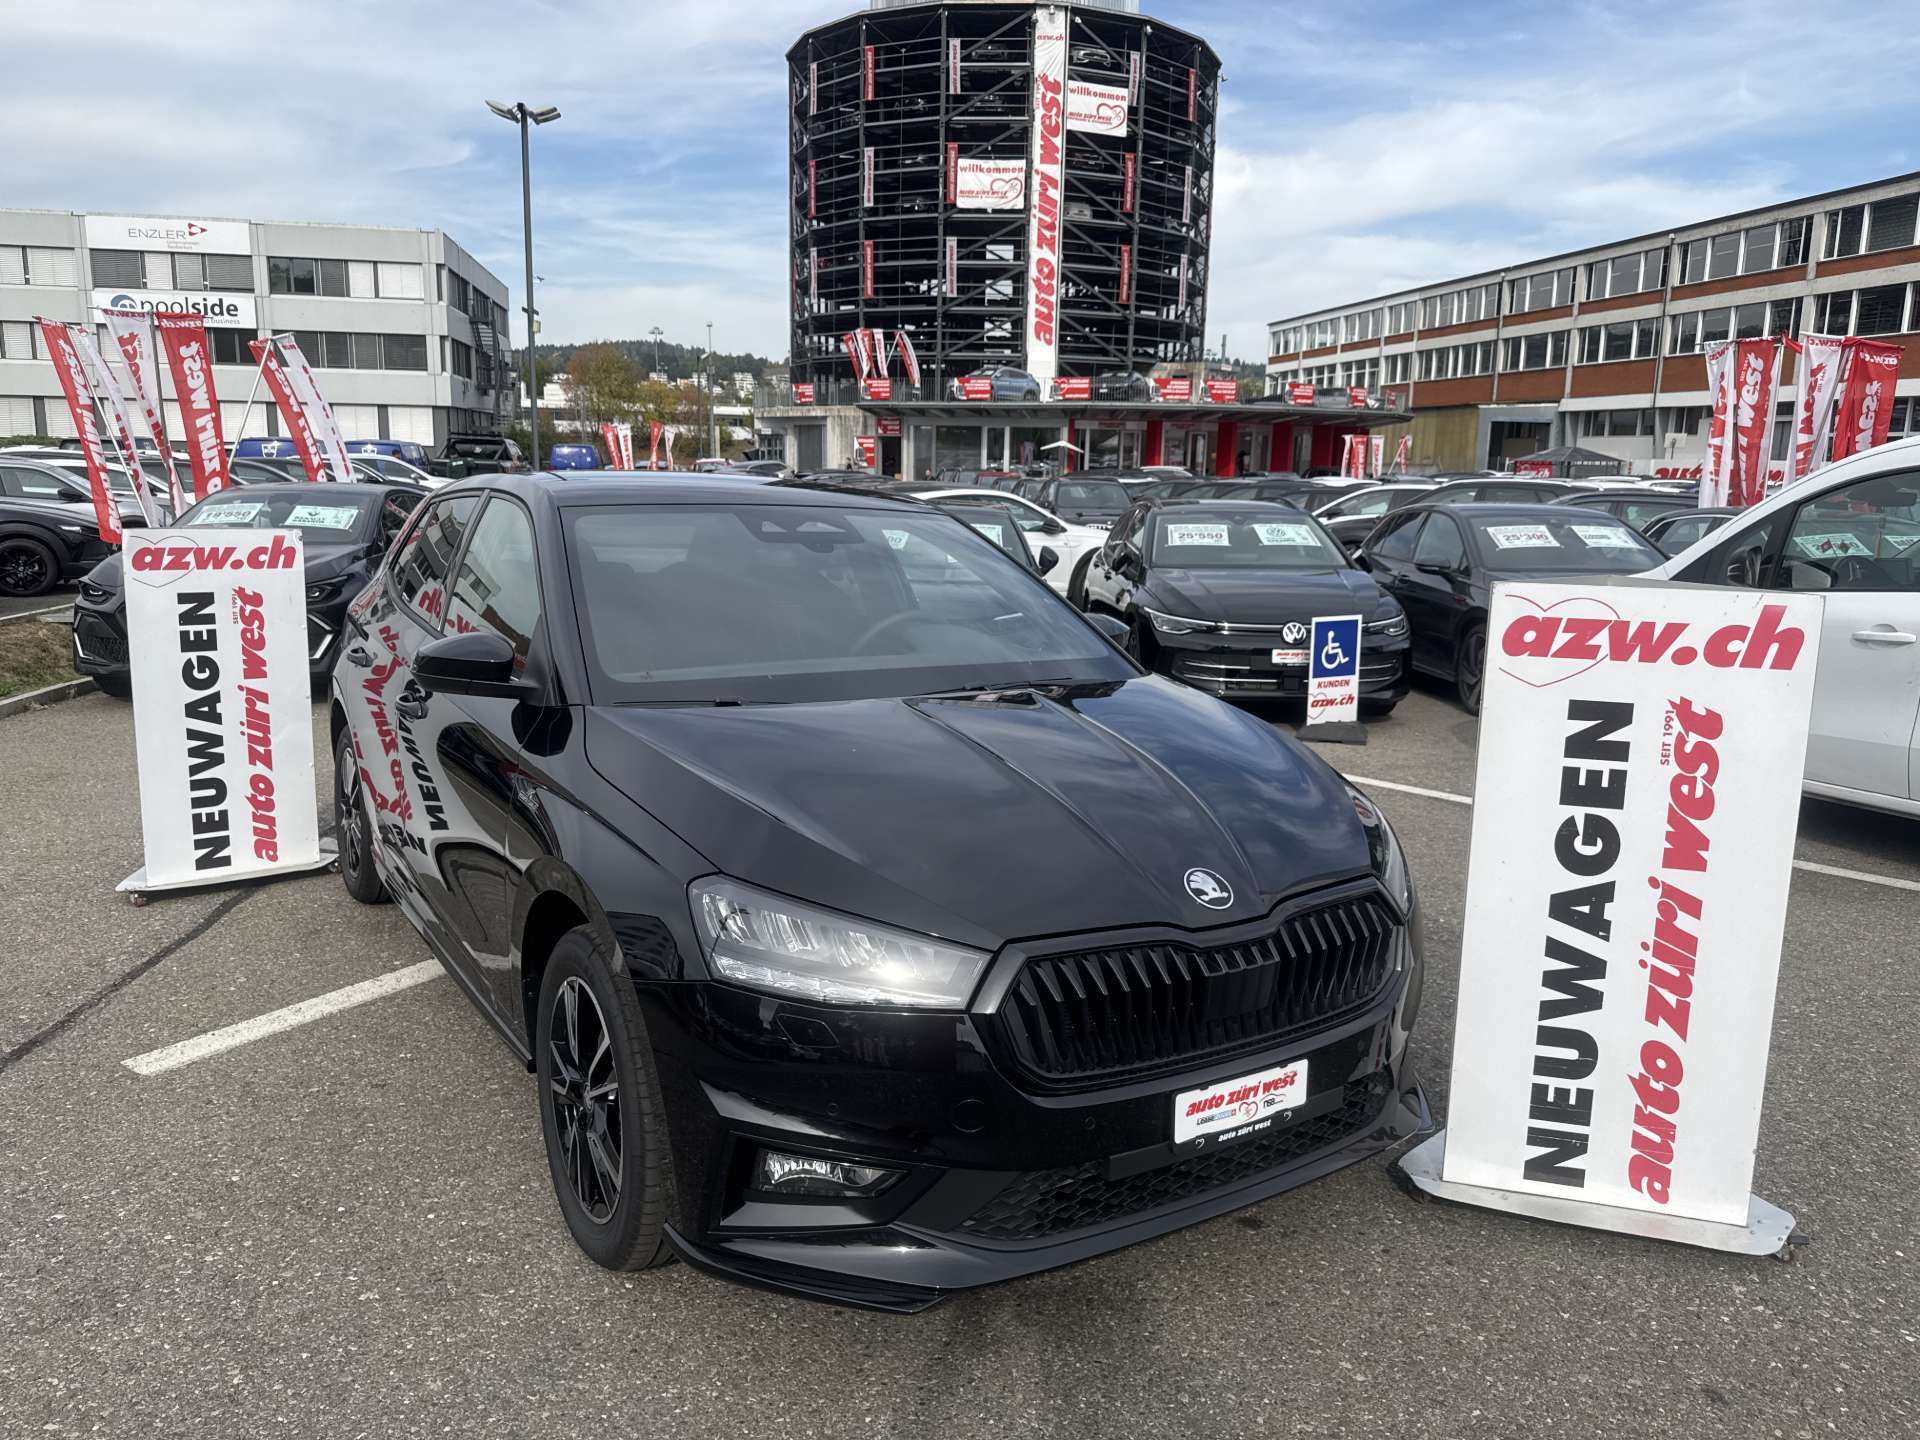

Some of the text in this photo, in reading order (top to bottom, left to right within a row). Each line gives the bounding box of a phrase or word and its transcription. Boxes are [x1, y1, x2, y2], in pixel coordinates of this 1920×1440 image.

[1037, 33, 1064, 41] azw.ch
[1069, 86, 1127, 102] willkommen
[959, 163, 1024, 173] willkommen
[1032, 73, 1062, 346] auto züri west
[128, 228, 186, 240] ENZLER
[1738, 352, 1764, 428] west
[131, 535, 297, 573] azw.ch
[232, 608, 240, 625] SEIT
[1501, 605, 1805, 671] azw.ch
[1311, 694, 1355, 708] azw.ch
[1317, 680, 1350, 689] KUNDEN
[176, 591, 232, 872] NEUWAGEN
[232, 585, 279, 863] auto züri west
[1659, 708, 1675, 766] SEIT 1991
[1523, 698, 1636, 1188] NEUWAGEN
[1627, 695, 1724, 1205] auto züri west
[1186, 1091, 1225, 1117] auto
[1225, 1079, 1262, 1105] züri
[1263, 1070, 1298, 1095] west
[1218, 1131, 1236, 1142] auto
[1254, 1119, 1272, 1131] west
